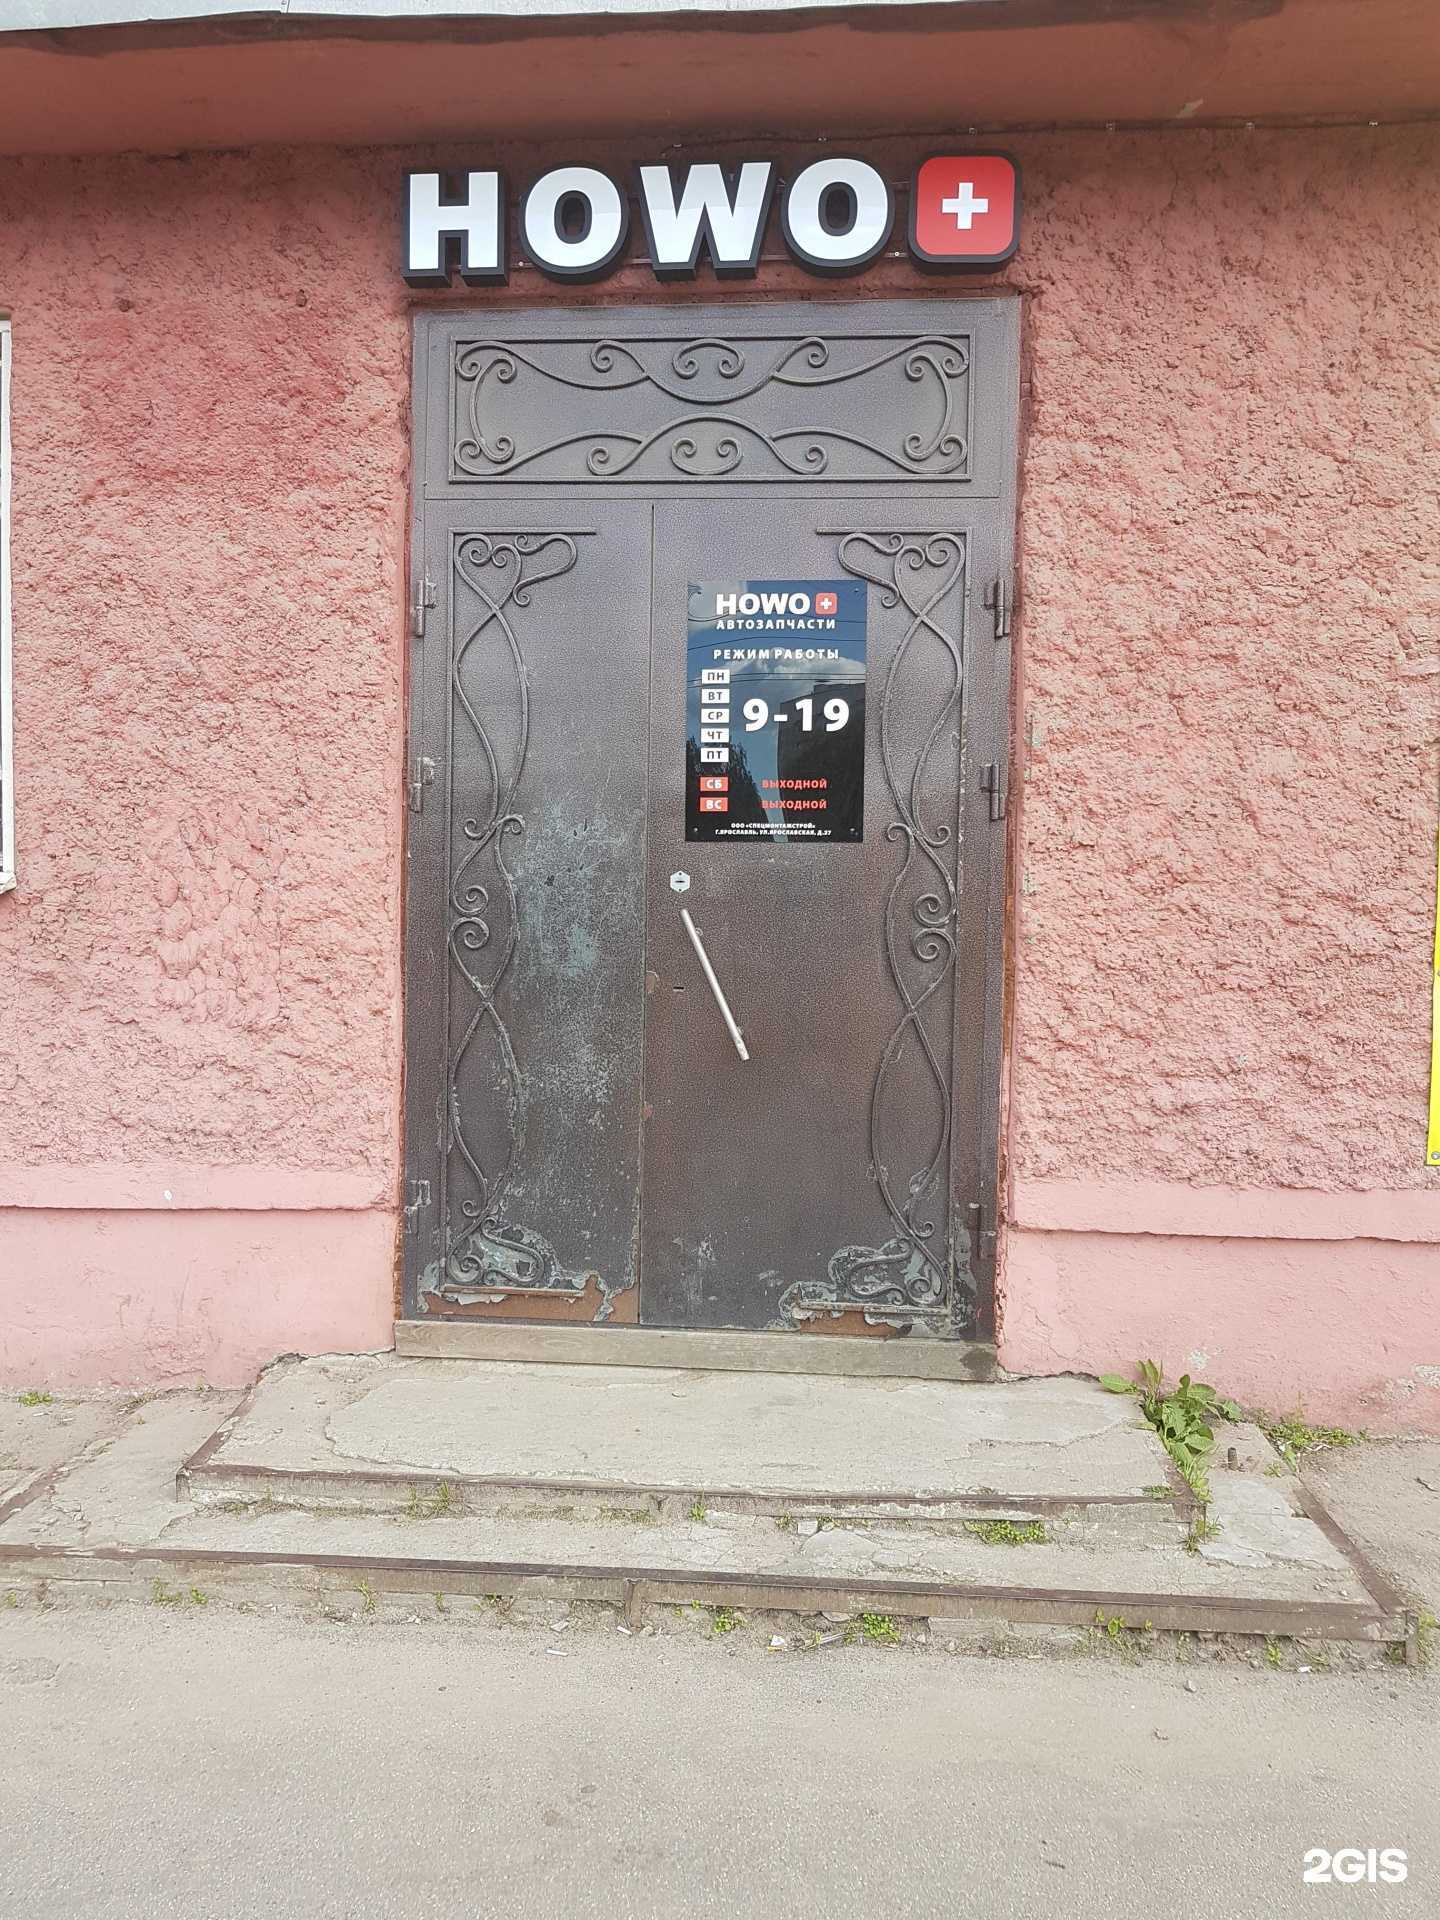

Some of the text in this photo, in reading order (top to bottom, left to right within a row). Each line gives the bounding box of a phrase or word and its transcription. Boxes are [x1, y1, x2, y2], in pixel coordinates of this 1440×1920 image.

[408, 157, 889, 271] HOWO
[716, 592, 811, 615] HOWO
[716, 619, 836, 630] АВТОЗАПЧАСТИ
[713, 648, 839, 660] РЕЖИМ РАБОТЫ
[706, 671, 726, 682] ПН
[707, 691, 724, 701] ВТ
[707, 711, 724, 721] СР
[742, 698, 850, 732] 9-19
[706, 730, 723, 740] ЧТ
[706, 750, 723, 760] ПТ
[706, 778, 827, 791] СБ ВЫХОДНОЙ
[705, 799, 827, 811] ВС ВЫХОДНОЙ
